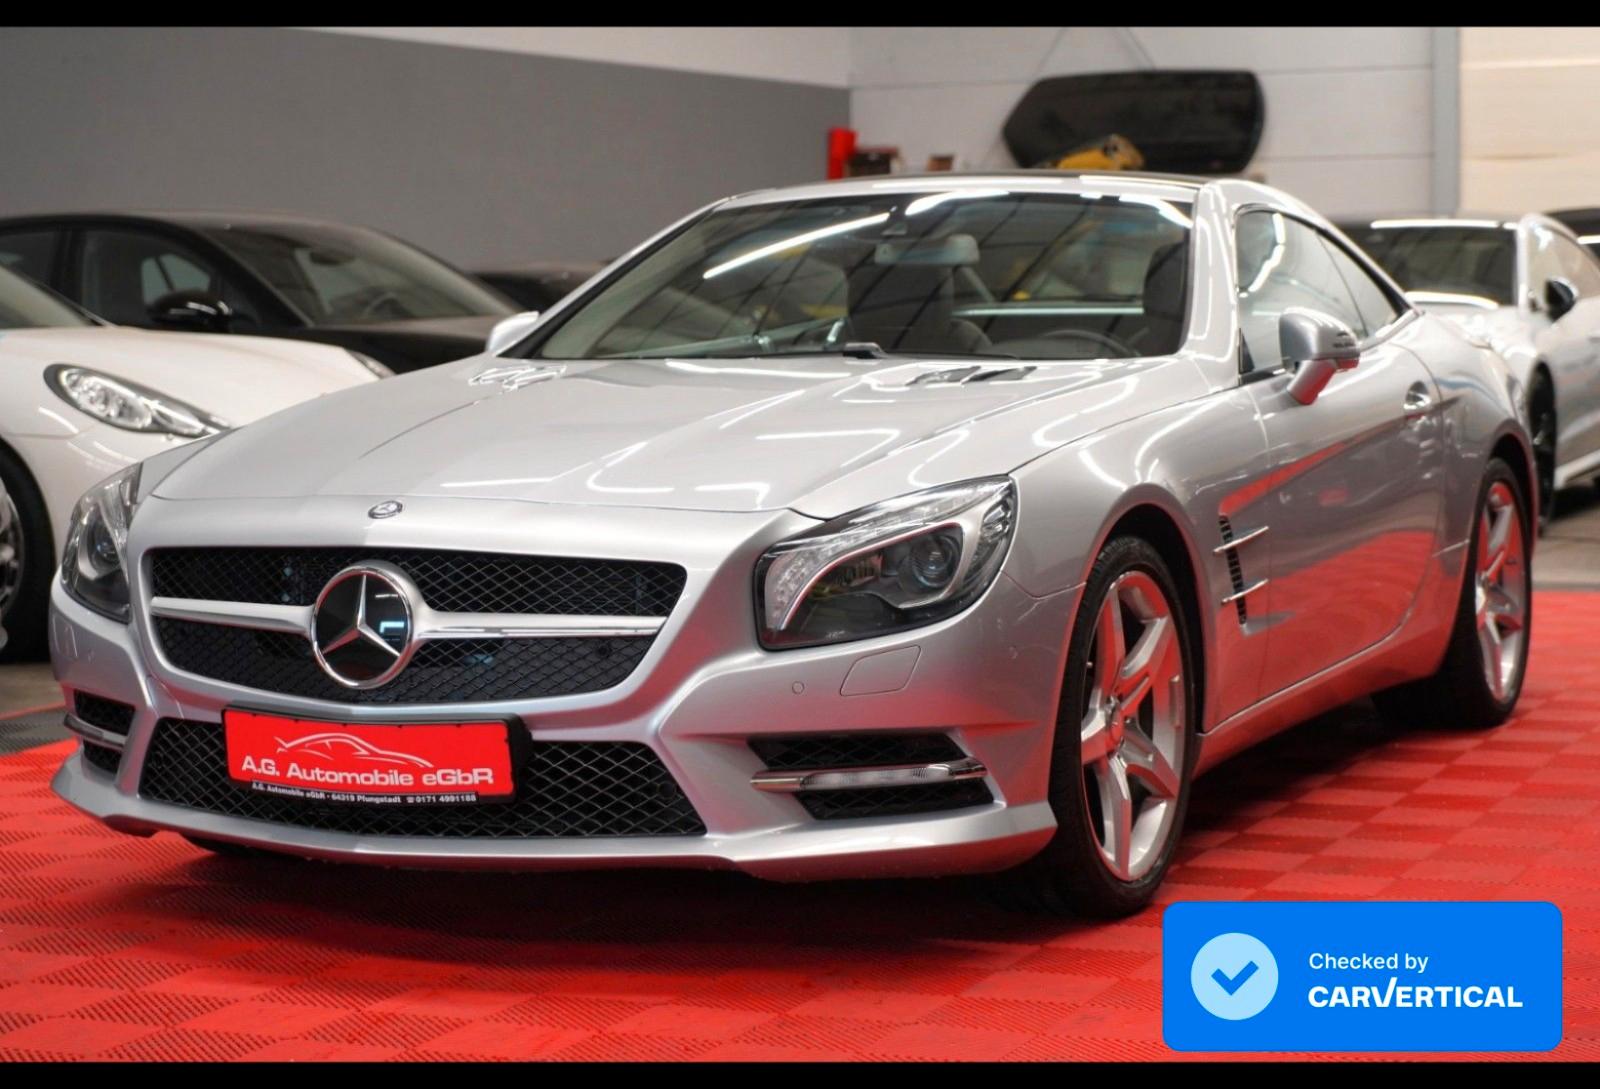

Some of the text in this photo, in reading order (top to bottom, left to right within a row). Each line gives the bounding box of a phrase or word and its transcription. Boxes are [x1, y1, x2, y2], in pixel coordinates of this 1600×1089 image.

[241, 755, 494, 786] A.G. Automobile eGbR
[252, 782, 266, 791] A.G.
[266, 784, 305, 797] Automobile
[305, 791, 326, 800] eGbR
[331, 793, 355, 802] 64319
[356, 794, 401, 804] Pfungstadt
